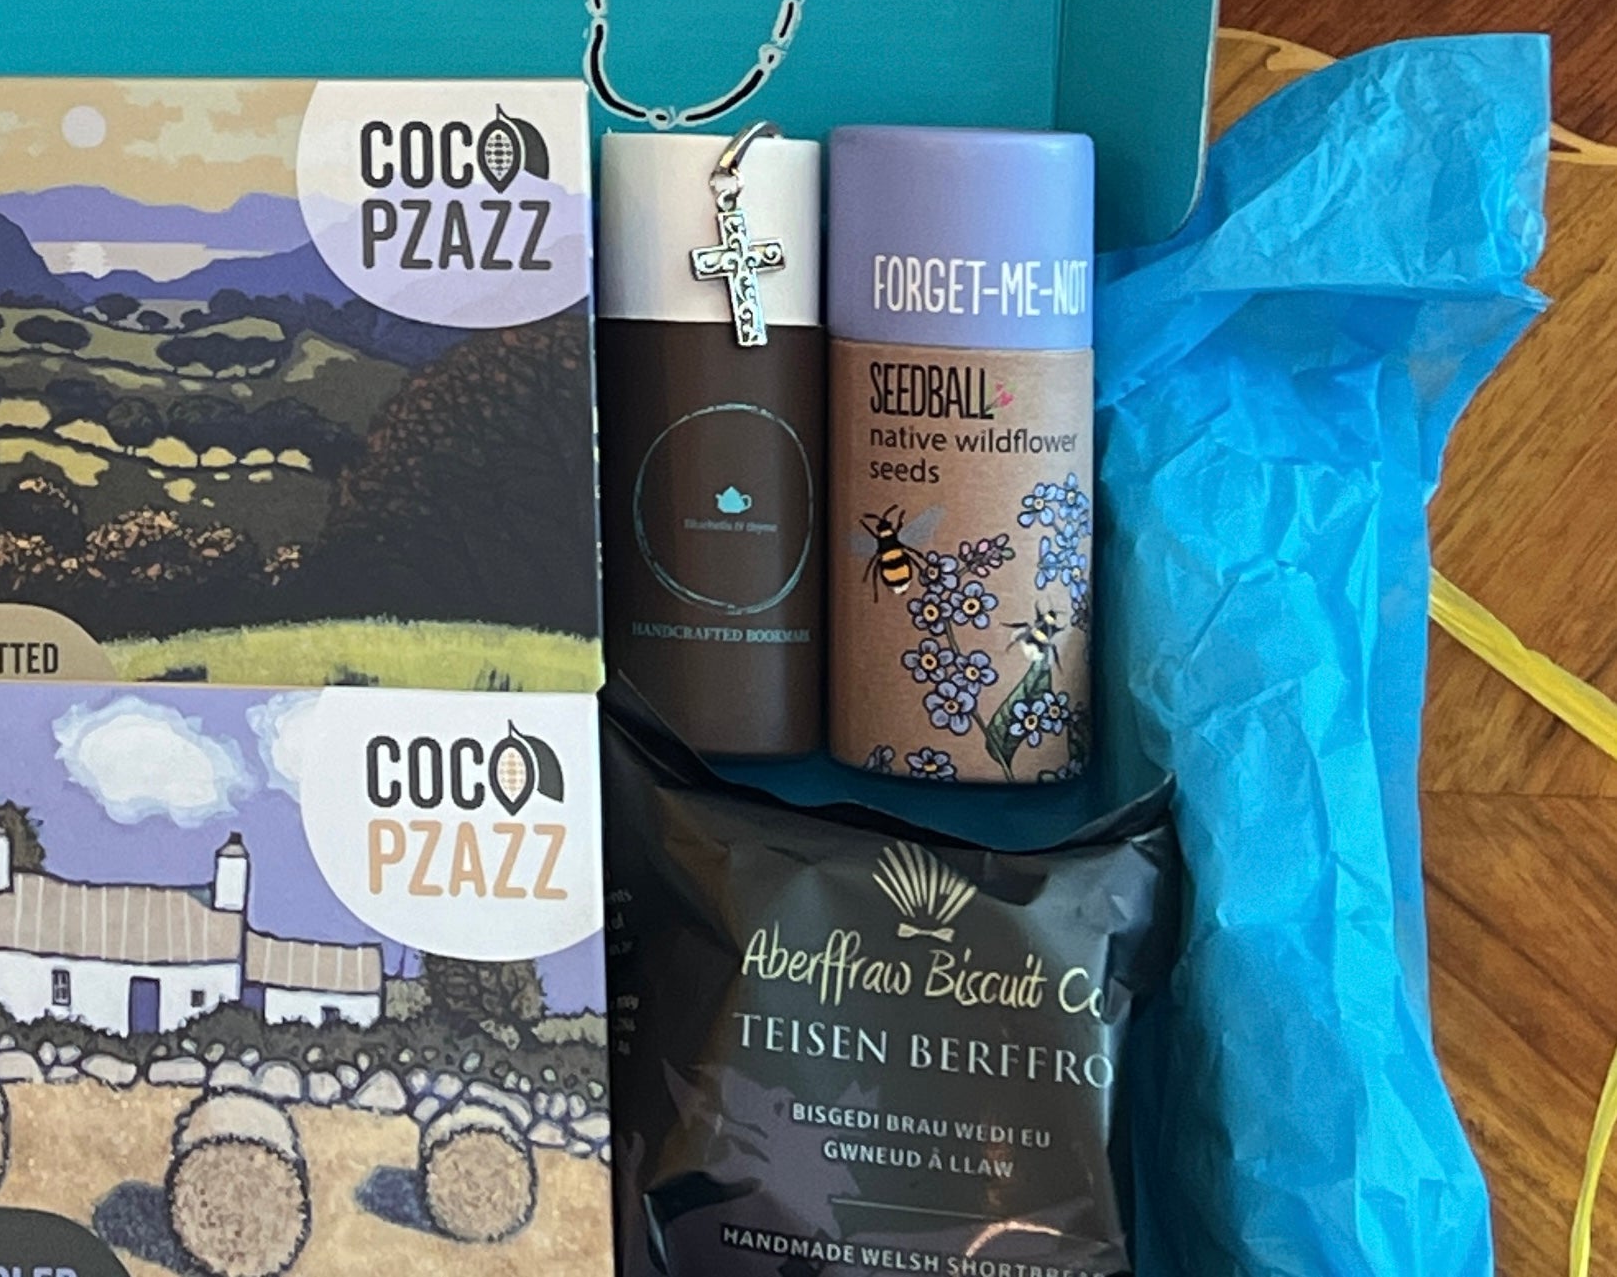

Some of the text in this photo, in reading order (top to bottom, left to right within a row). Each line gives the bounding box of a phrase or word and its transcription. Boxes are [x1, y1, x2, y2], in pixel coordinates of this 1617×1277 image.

[361, 199, 552, 271] PZAZZ
[874, 254, 1088, 318] FORGET-ME-NOT
[870, 361, 994, 420] SEEDBALL
[870, 425, 1078, 455] native wildflower
[870, 457, 940, 483] seeds
[632, 622, 743, 643] HANDCRAFTED
[366, 819, 568, 901] PZAZZ
[741, 921, 912, 1007] Aberffraw
[924, 948, 1048, 1008] Biscuit
[733, 1011, 1114, 1089] TEISEN BERFFRO
[792, 1102, 1051, 1148] BISGEDI BRAU WEDI EU
[823, 1140, 921, 1169] GWNEUD
[950, 1154, 1014, 1180] LLAW
[723, 1227, 855, 1265] HANDMADE
[861, 1248, 939, 1273] WELSH
